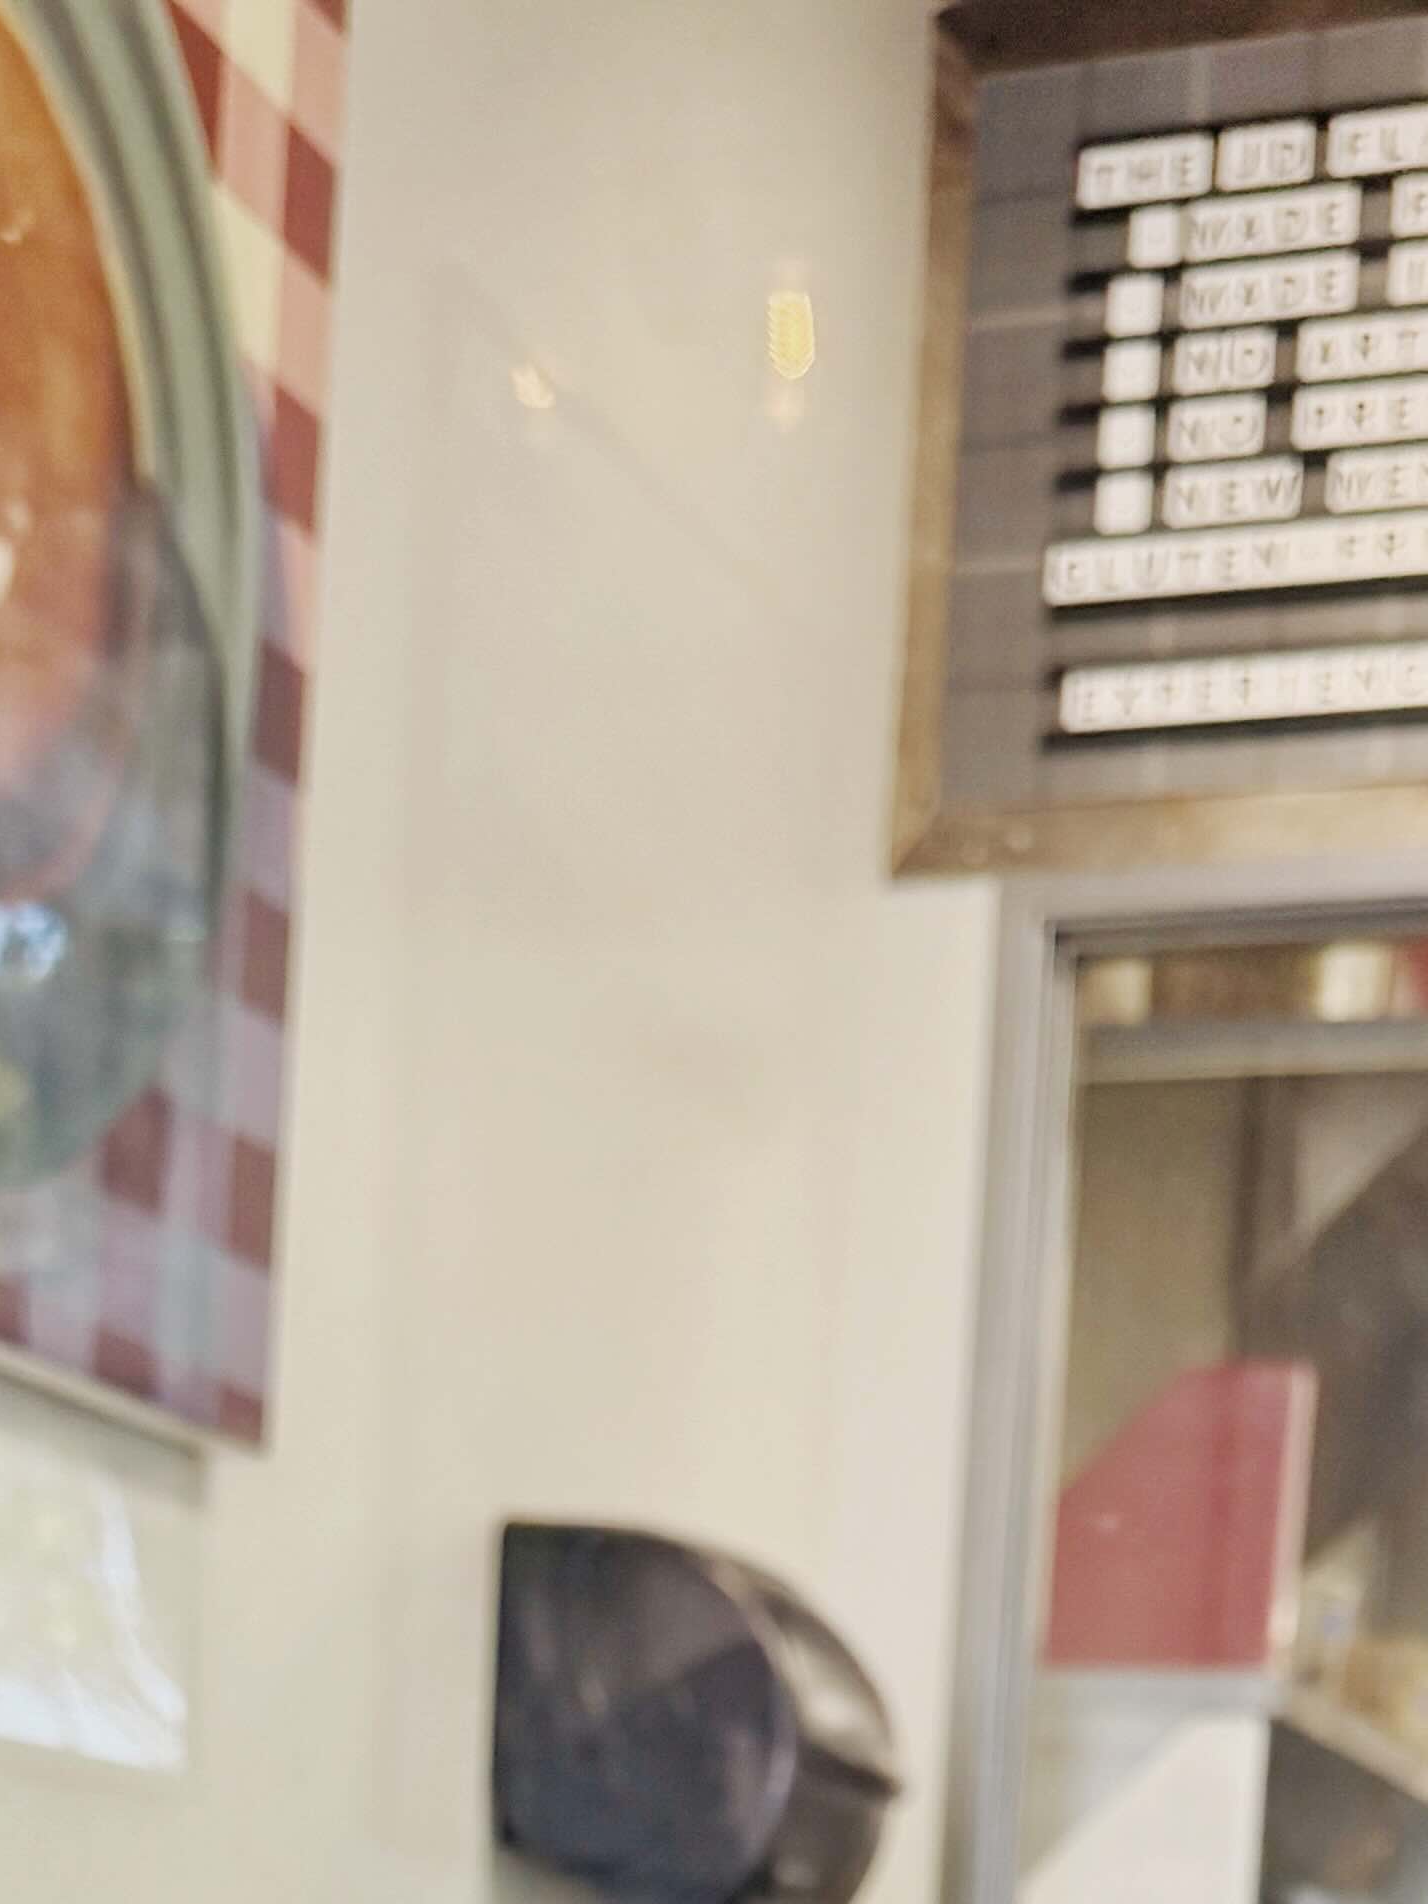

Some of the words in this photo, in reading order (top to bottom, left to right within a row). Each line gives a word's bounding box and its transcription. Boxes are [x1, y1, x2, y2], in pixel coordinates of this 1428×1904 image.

[1088, 144, 1202, 197] THE
[1185, 198, 1345, 256] MADE
[1180, 265, 1344, 320] MADE
